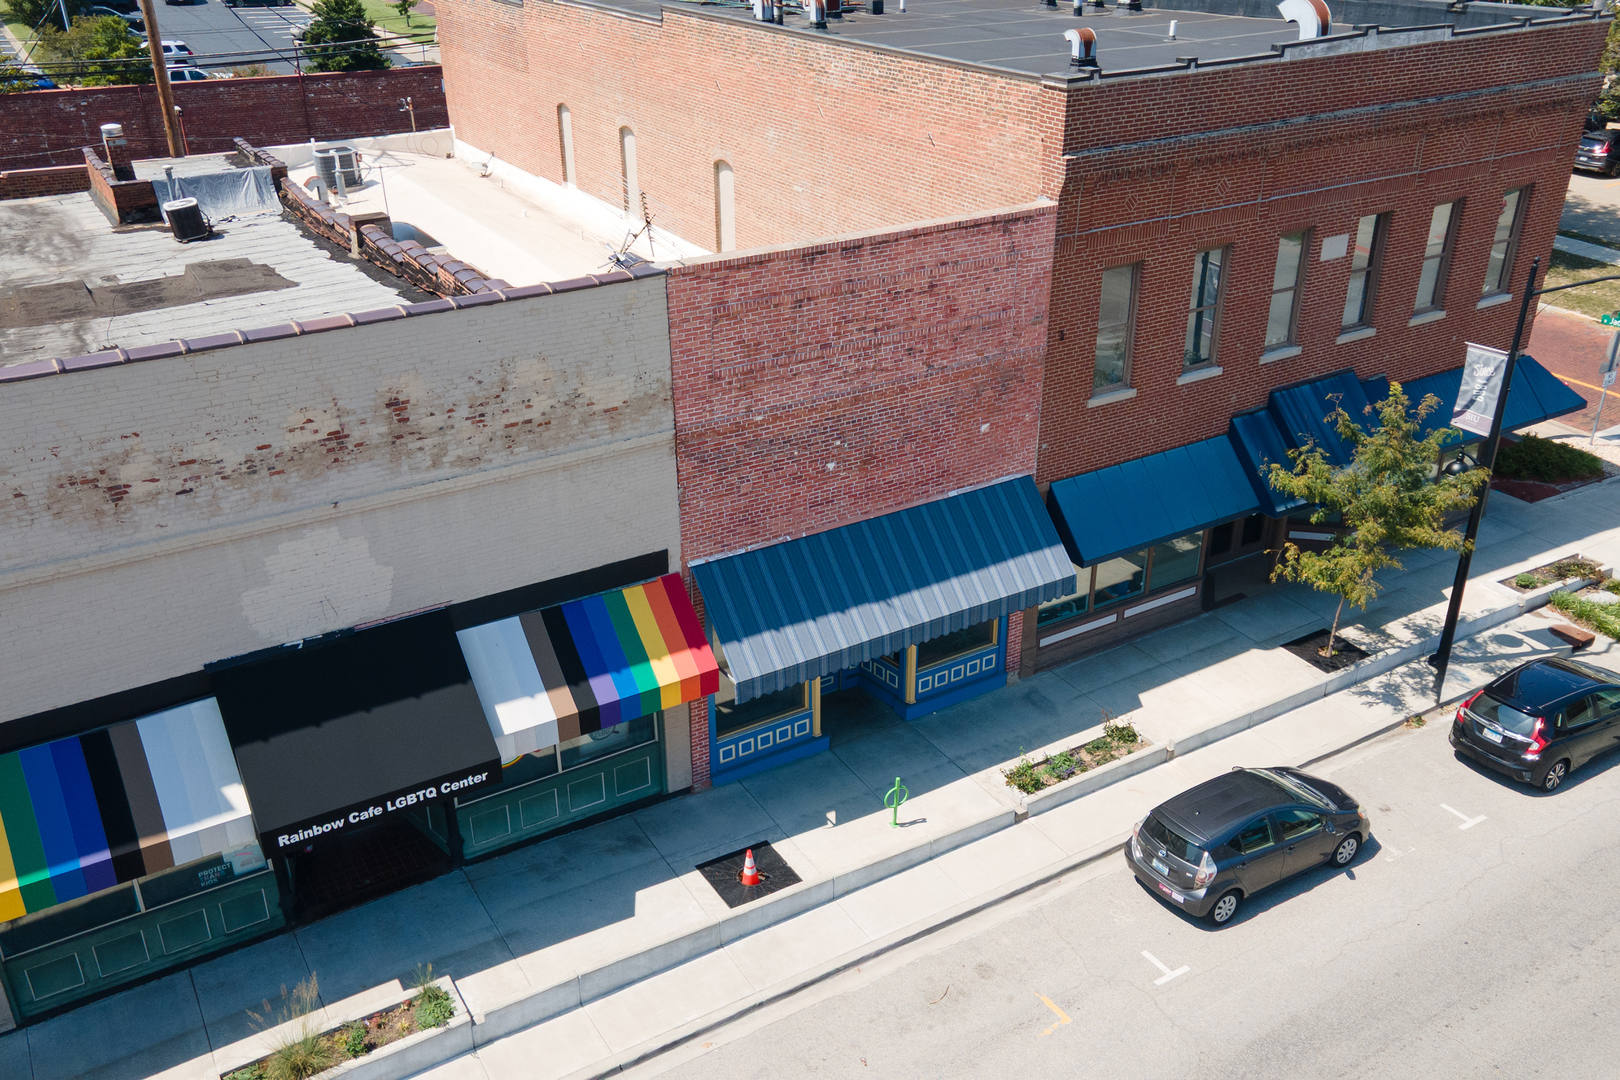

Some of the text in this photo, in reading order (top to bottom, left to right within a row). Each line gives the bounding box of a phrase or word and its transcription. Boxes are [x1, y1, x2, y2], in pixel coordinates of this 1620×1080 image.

[1473, 364, 1495, 377] Since
[1472, 378, 1488, 402] 1869
[1466, 413, 1480, 422] SIU
[278, 772, 488, 847] Rainbow Cafe LGBTQ Center
[198, 863, 231, 878] PROTECT
[200, 870, 226, 882] TRANS
